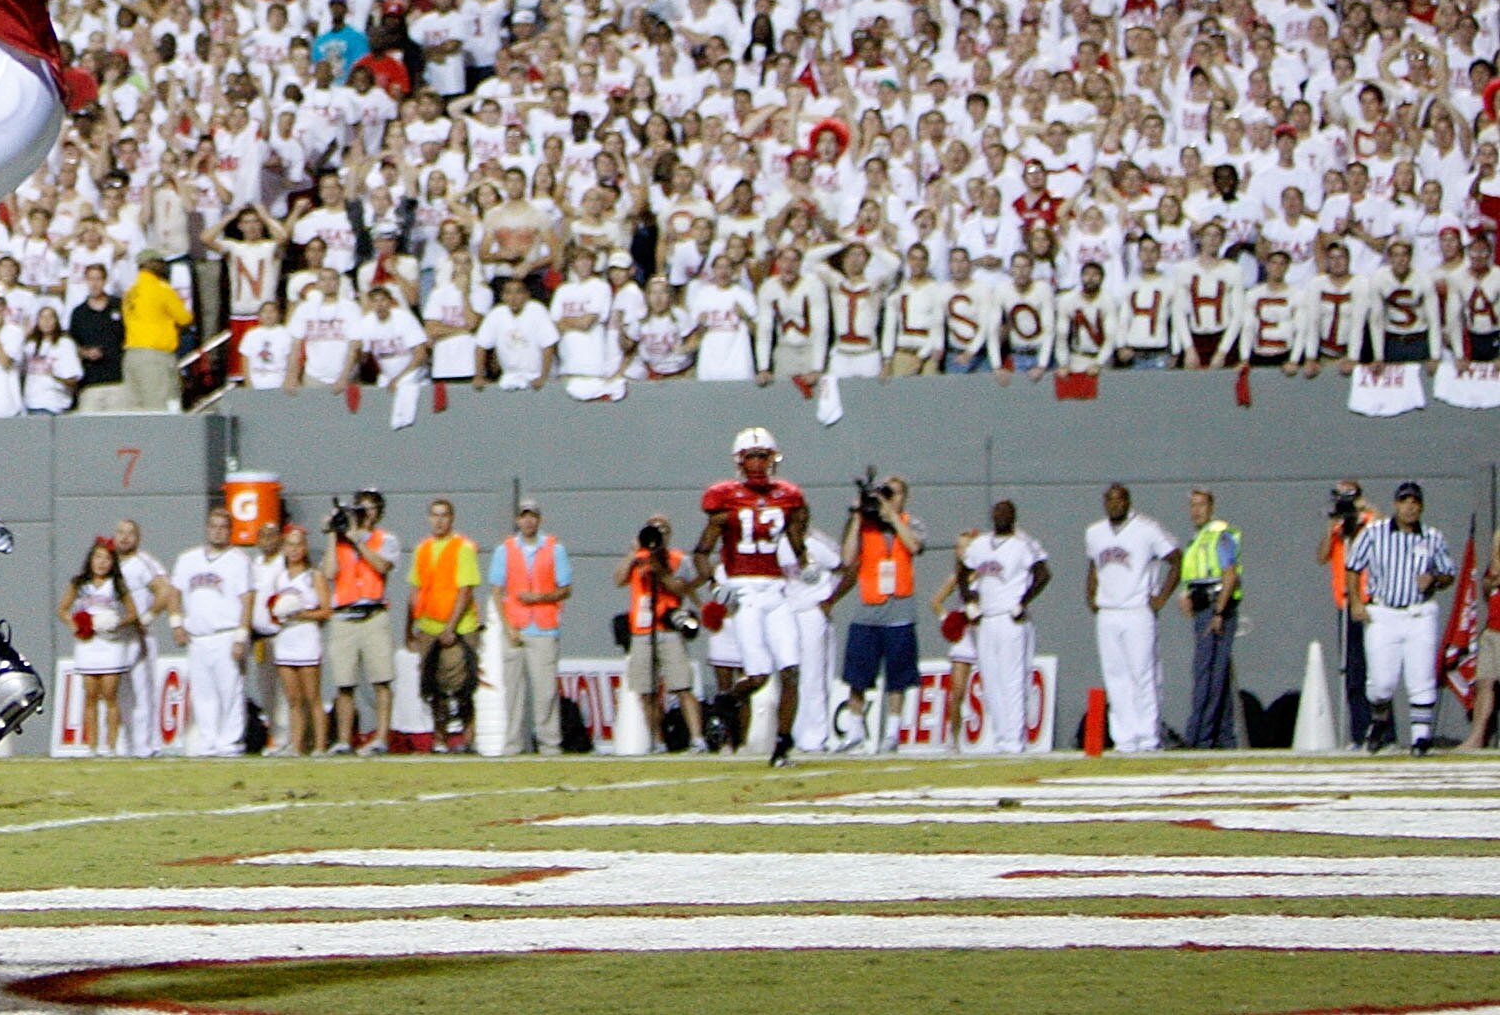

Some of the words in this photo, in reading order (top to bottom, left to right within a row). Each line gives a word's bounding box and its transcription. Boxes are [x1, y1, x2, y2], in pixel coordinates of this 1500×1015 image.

[116, 448, 142, 488] 7
[231, 492, 260, 522] G
[737, 508, 786, 555] 13
